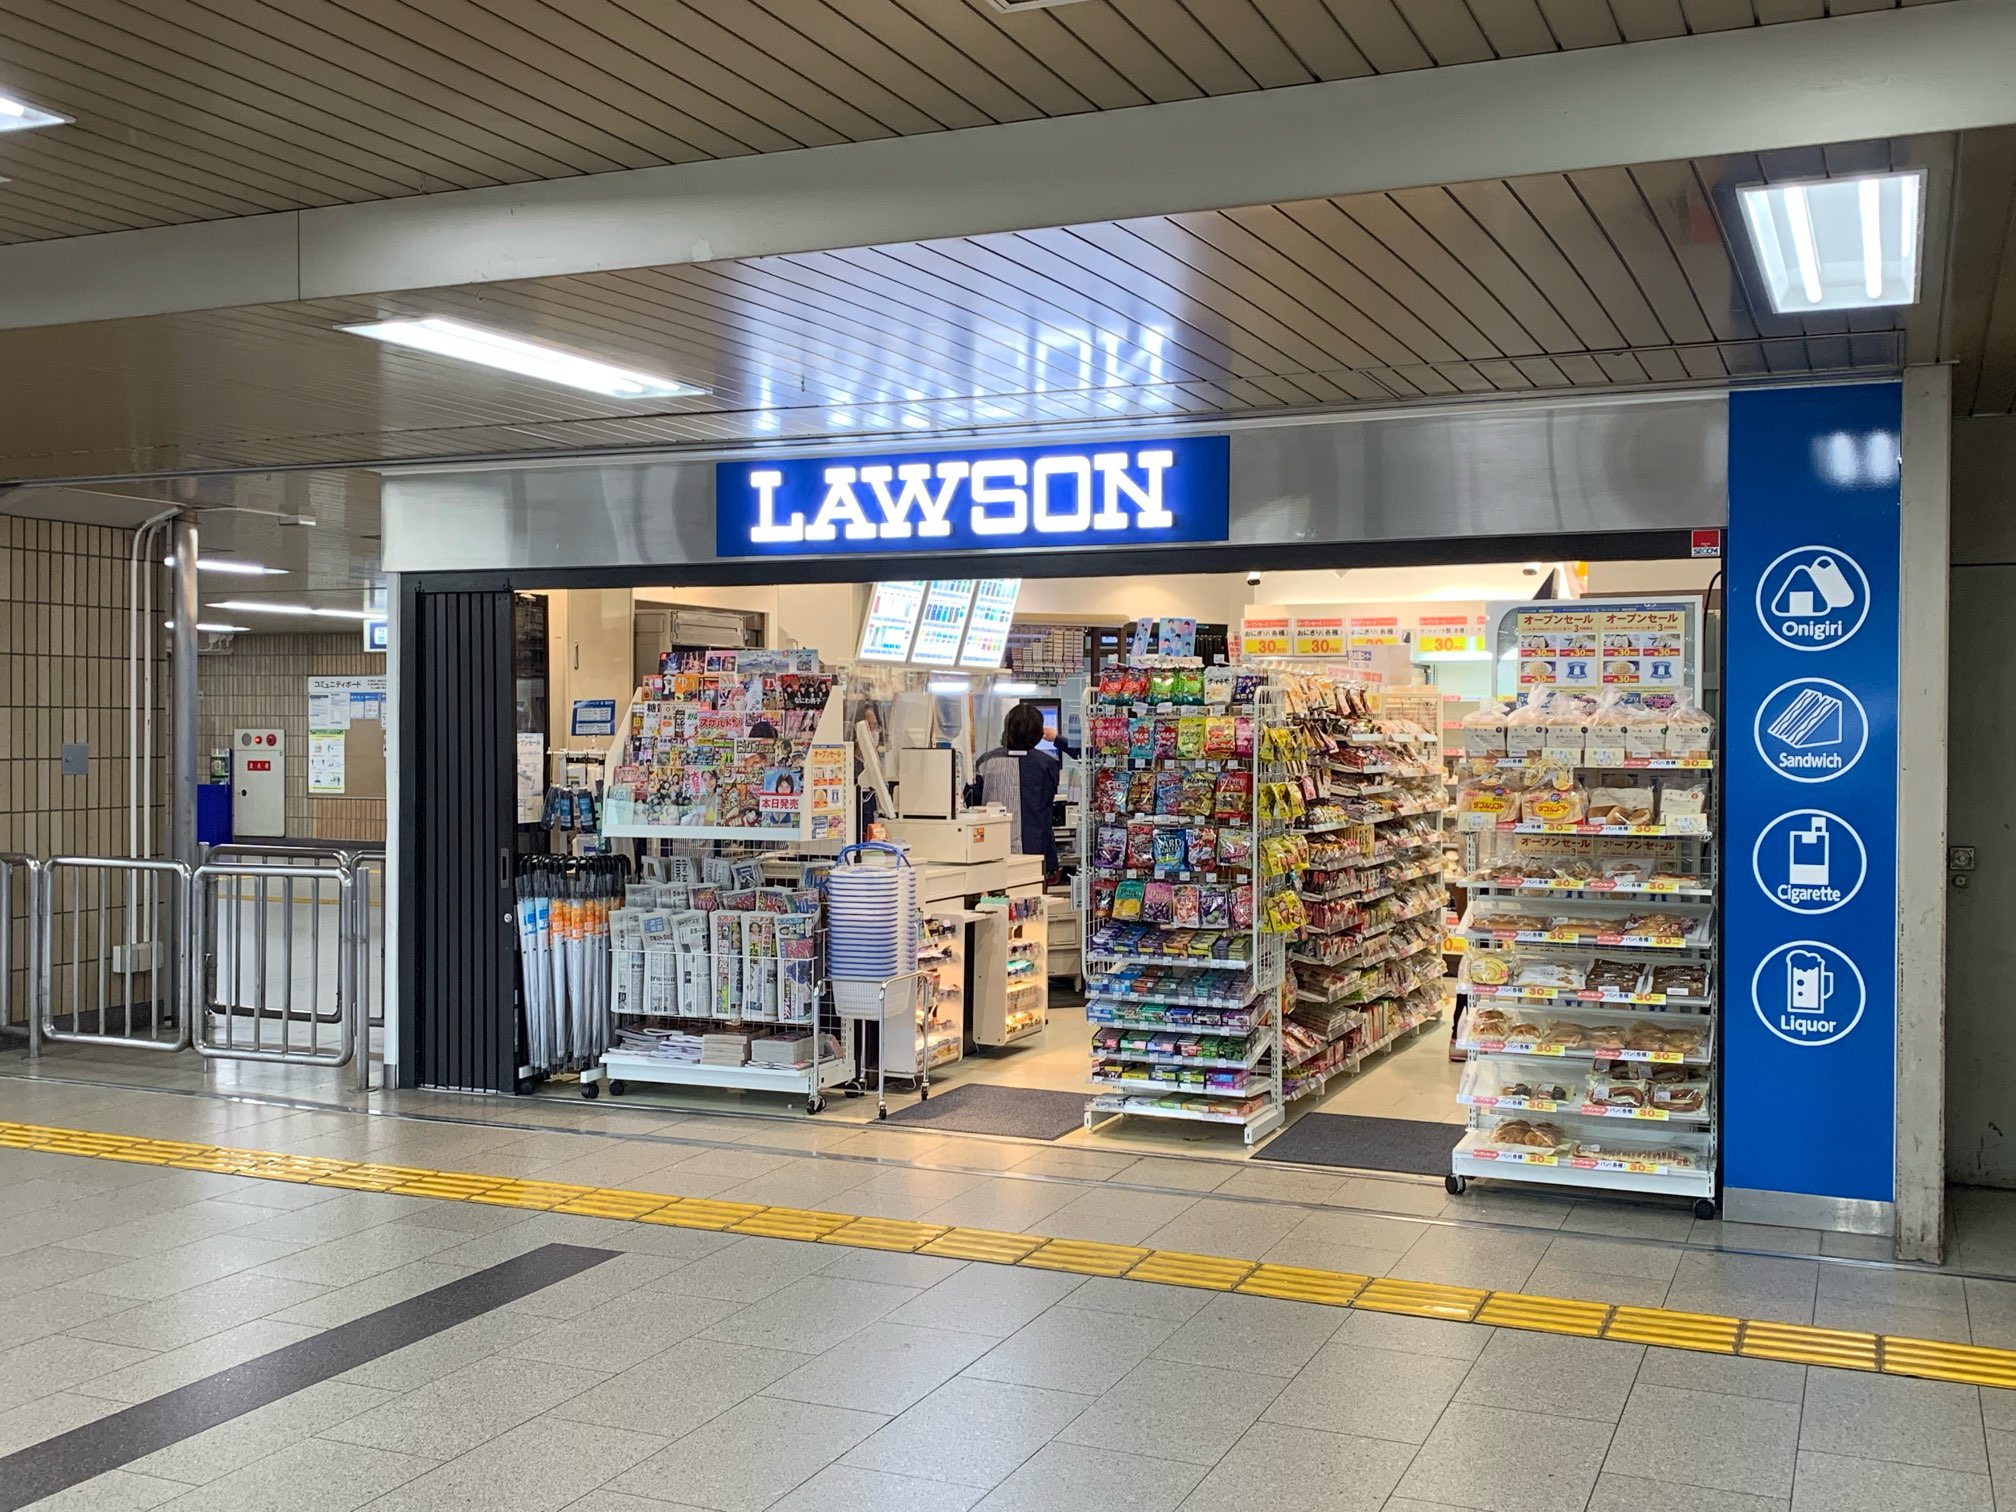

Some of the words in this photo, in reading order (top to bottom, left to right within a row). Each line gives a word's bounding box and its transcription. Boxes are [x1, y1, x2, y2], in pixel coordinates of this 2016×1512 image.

[750, 450, 1174, 543] LAWSON
[1524, 614, 1593, 625] オープンセール
[1606, 613, 1678, 624] オープンセール
[1781, 620, 1843, 640] Onigiri
[314, 680, 362, 688] コミュニティボード
[794, 696, 822, 705] なにわ男子
[1779, 752, 1842, 769] Sandwich
[761, 798, 799, 809] 本日発売
[1777, 884, 1841, 904] Cigarette
[1780, 1014, 1837, 1035] Liquor
